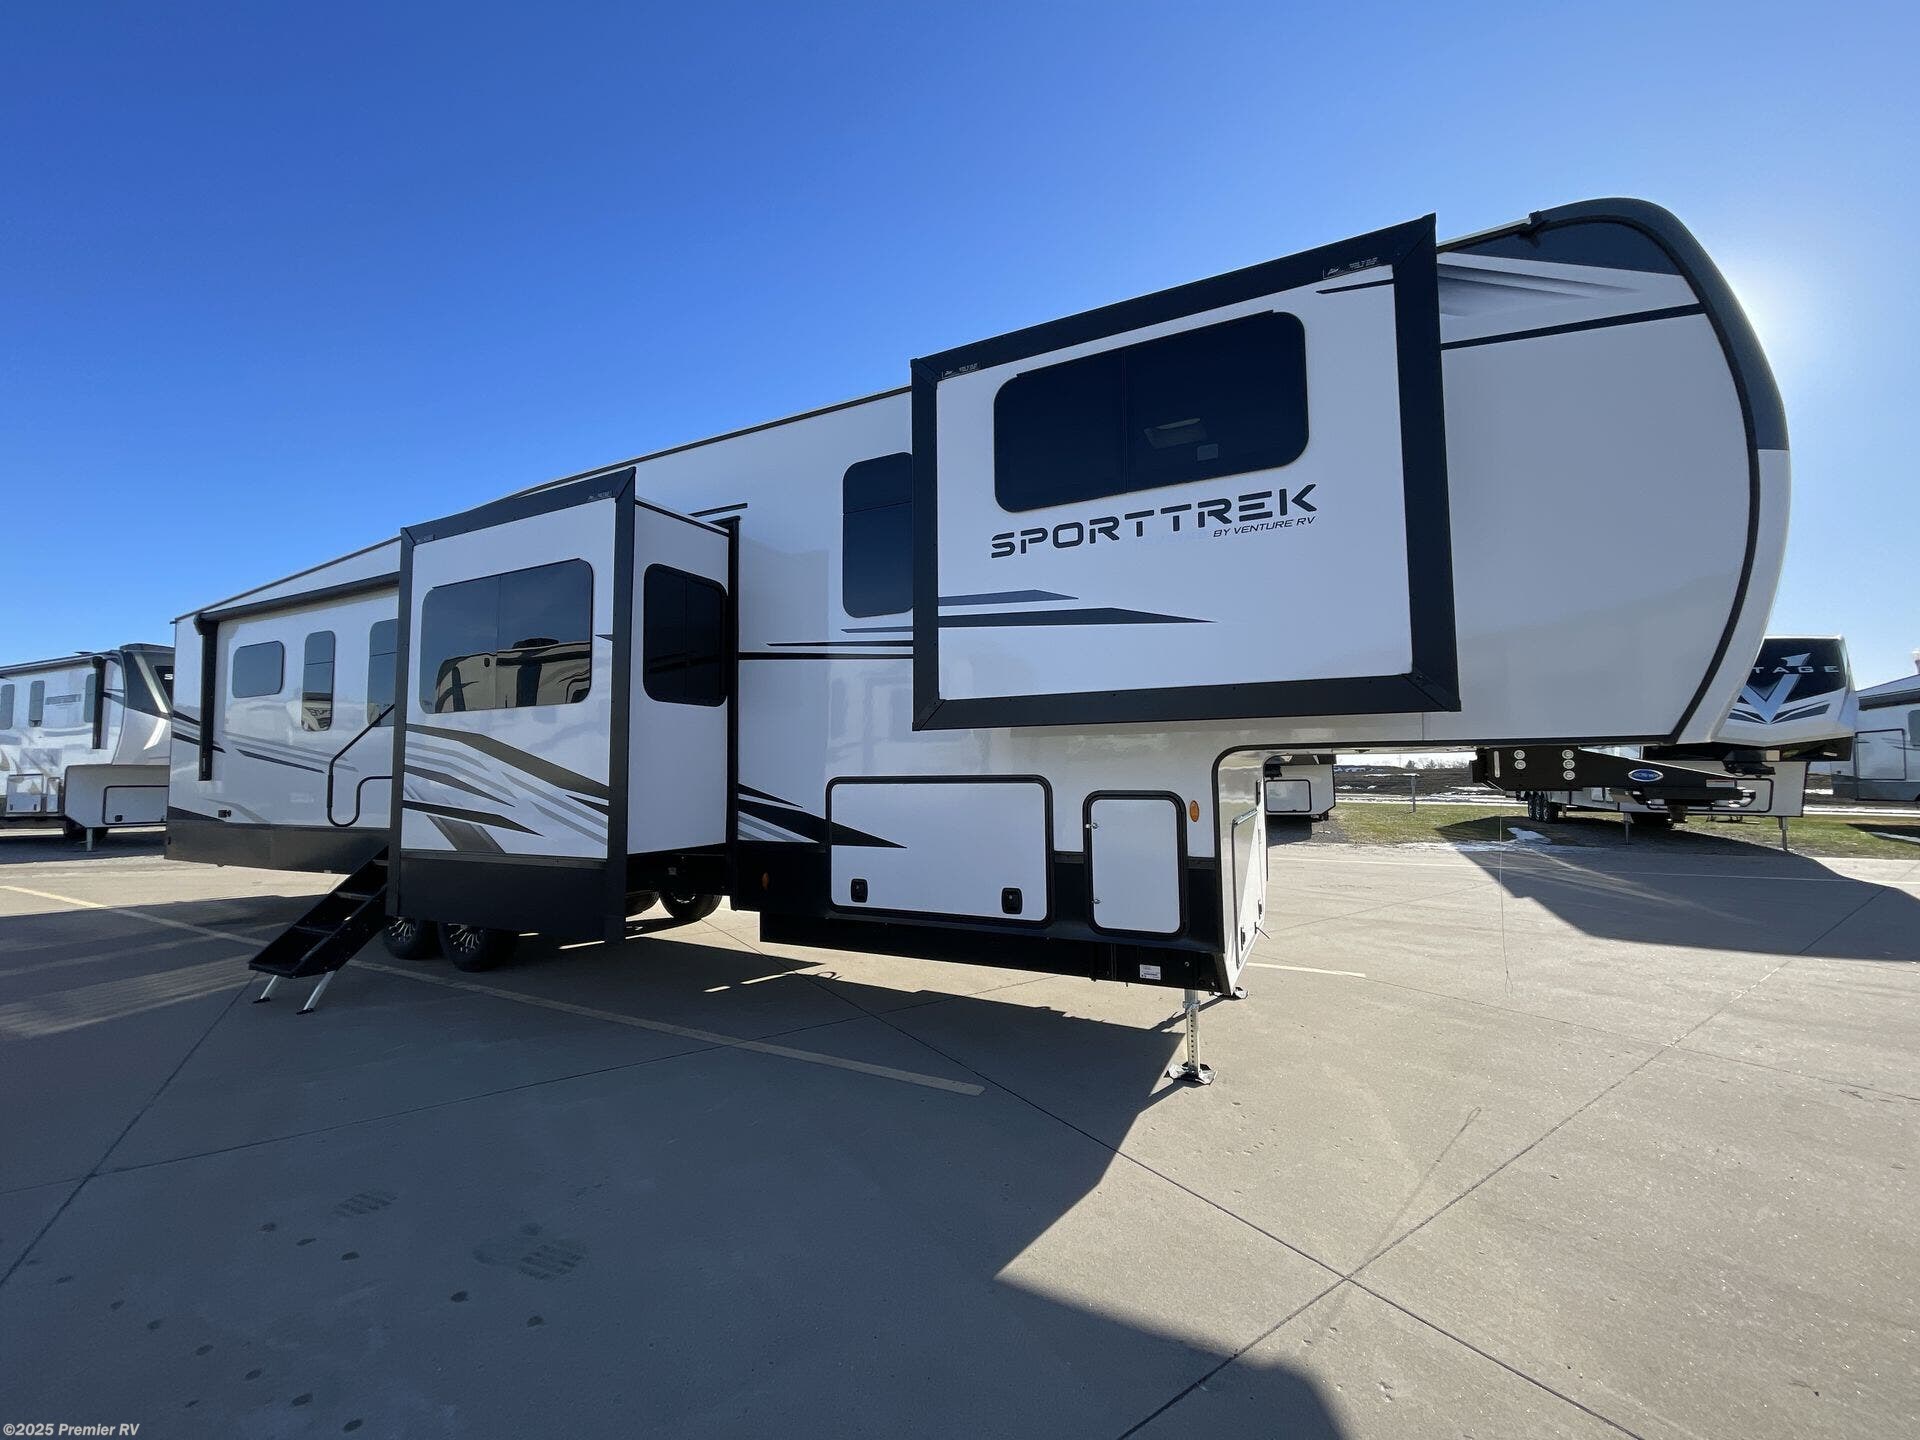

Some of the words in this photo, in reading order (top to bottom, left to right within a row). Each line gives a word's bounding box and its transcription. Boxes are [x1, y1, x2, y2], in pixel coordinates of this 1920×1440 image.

[991, 483, 1317, 559] SPORTTREK
[1213, 528, 1231, 538] BY
[1234, 519, 1294, 534] VENTURE
[1296, 516, 1316, 526] RV
